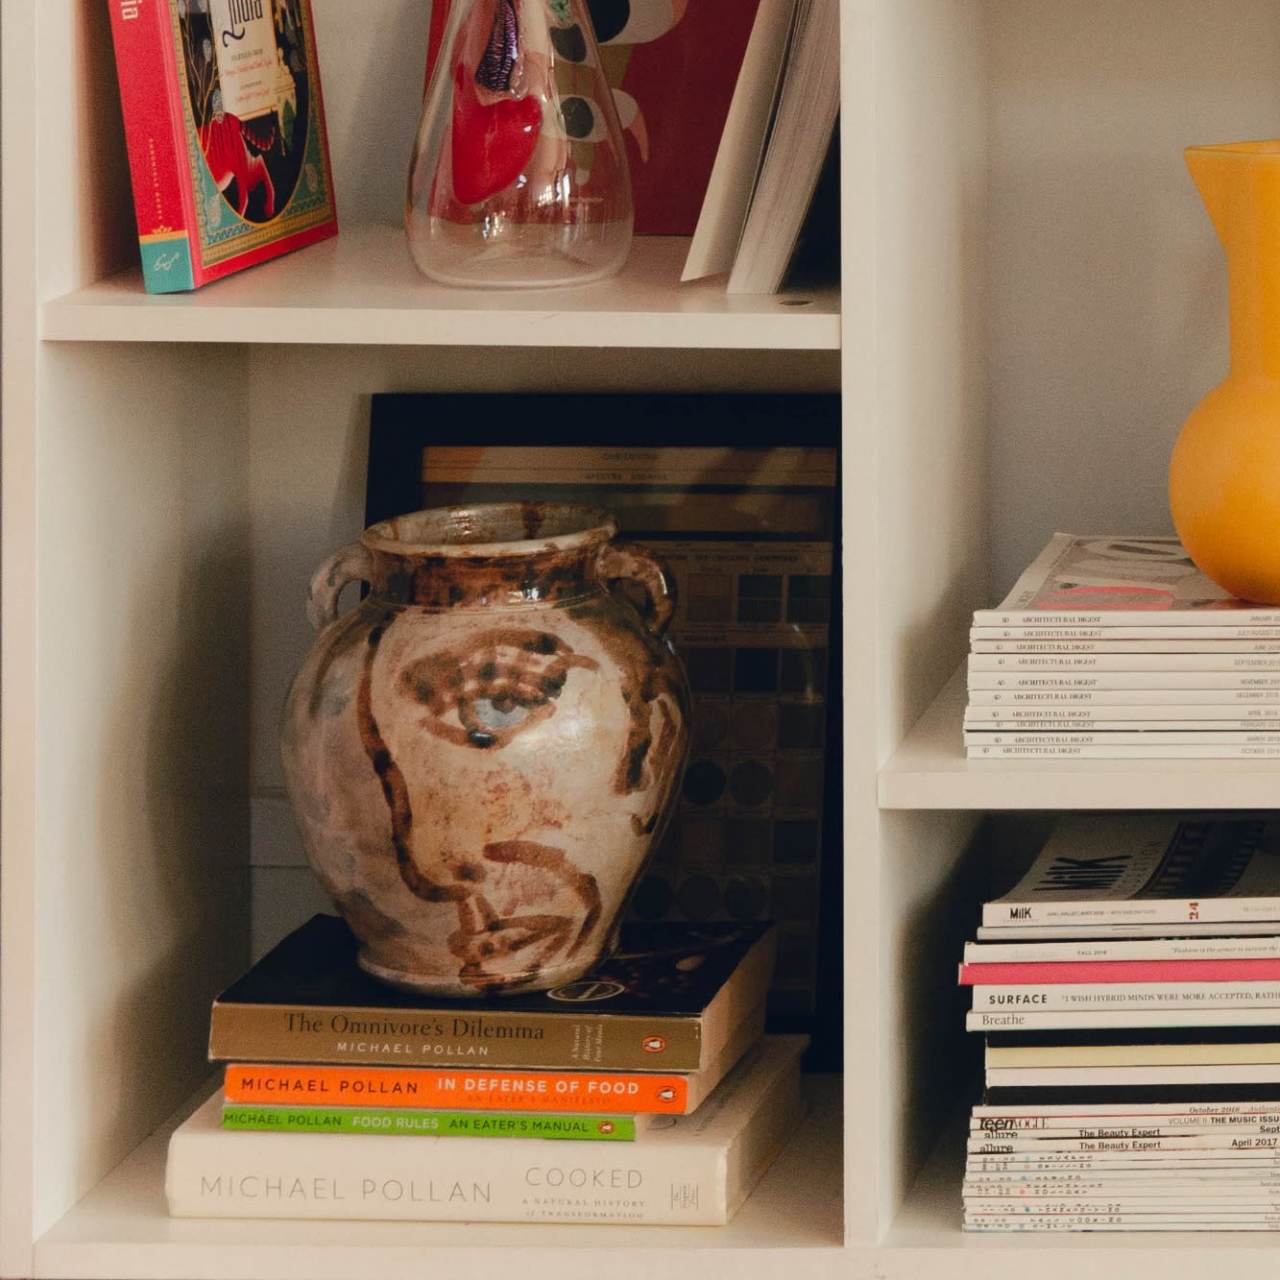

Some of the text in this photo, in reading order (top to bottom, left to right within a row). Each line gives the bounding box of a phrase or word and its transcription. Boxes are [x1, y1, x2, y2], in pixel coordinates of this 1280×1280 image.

[989, 994, 1047, 1005] SURFACE
[283, 1013, 544, 1040] The Omnivore's Dilemma
[982, 1014, 1025, 1026] Breathe
[241, 1078, 418, 1094] MICHAEL POLLAN
[438, 1078, 639, 1094] IN DEFENSE OF FOOD
[352, 1116, 439, 1129] FOOD RULES
[449, 1119, 589, 1132] AN EATER'S MANUAL
[1232, 1138, 1278, 1148] April 2017
[525, 1167, 642, 1189] COOKED
[200, 1175, 491, 1204] MICHAEL POLLAN
